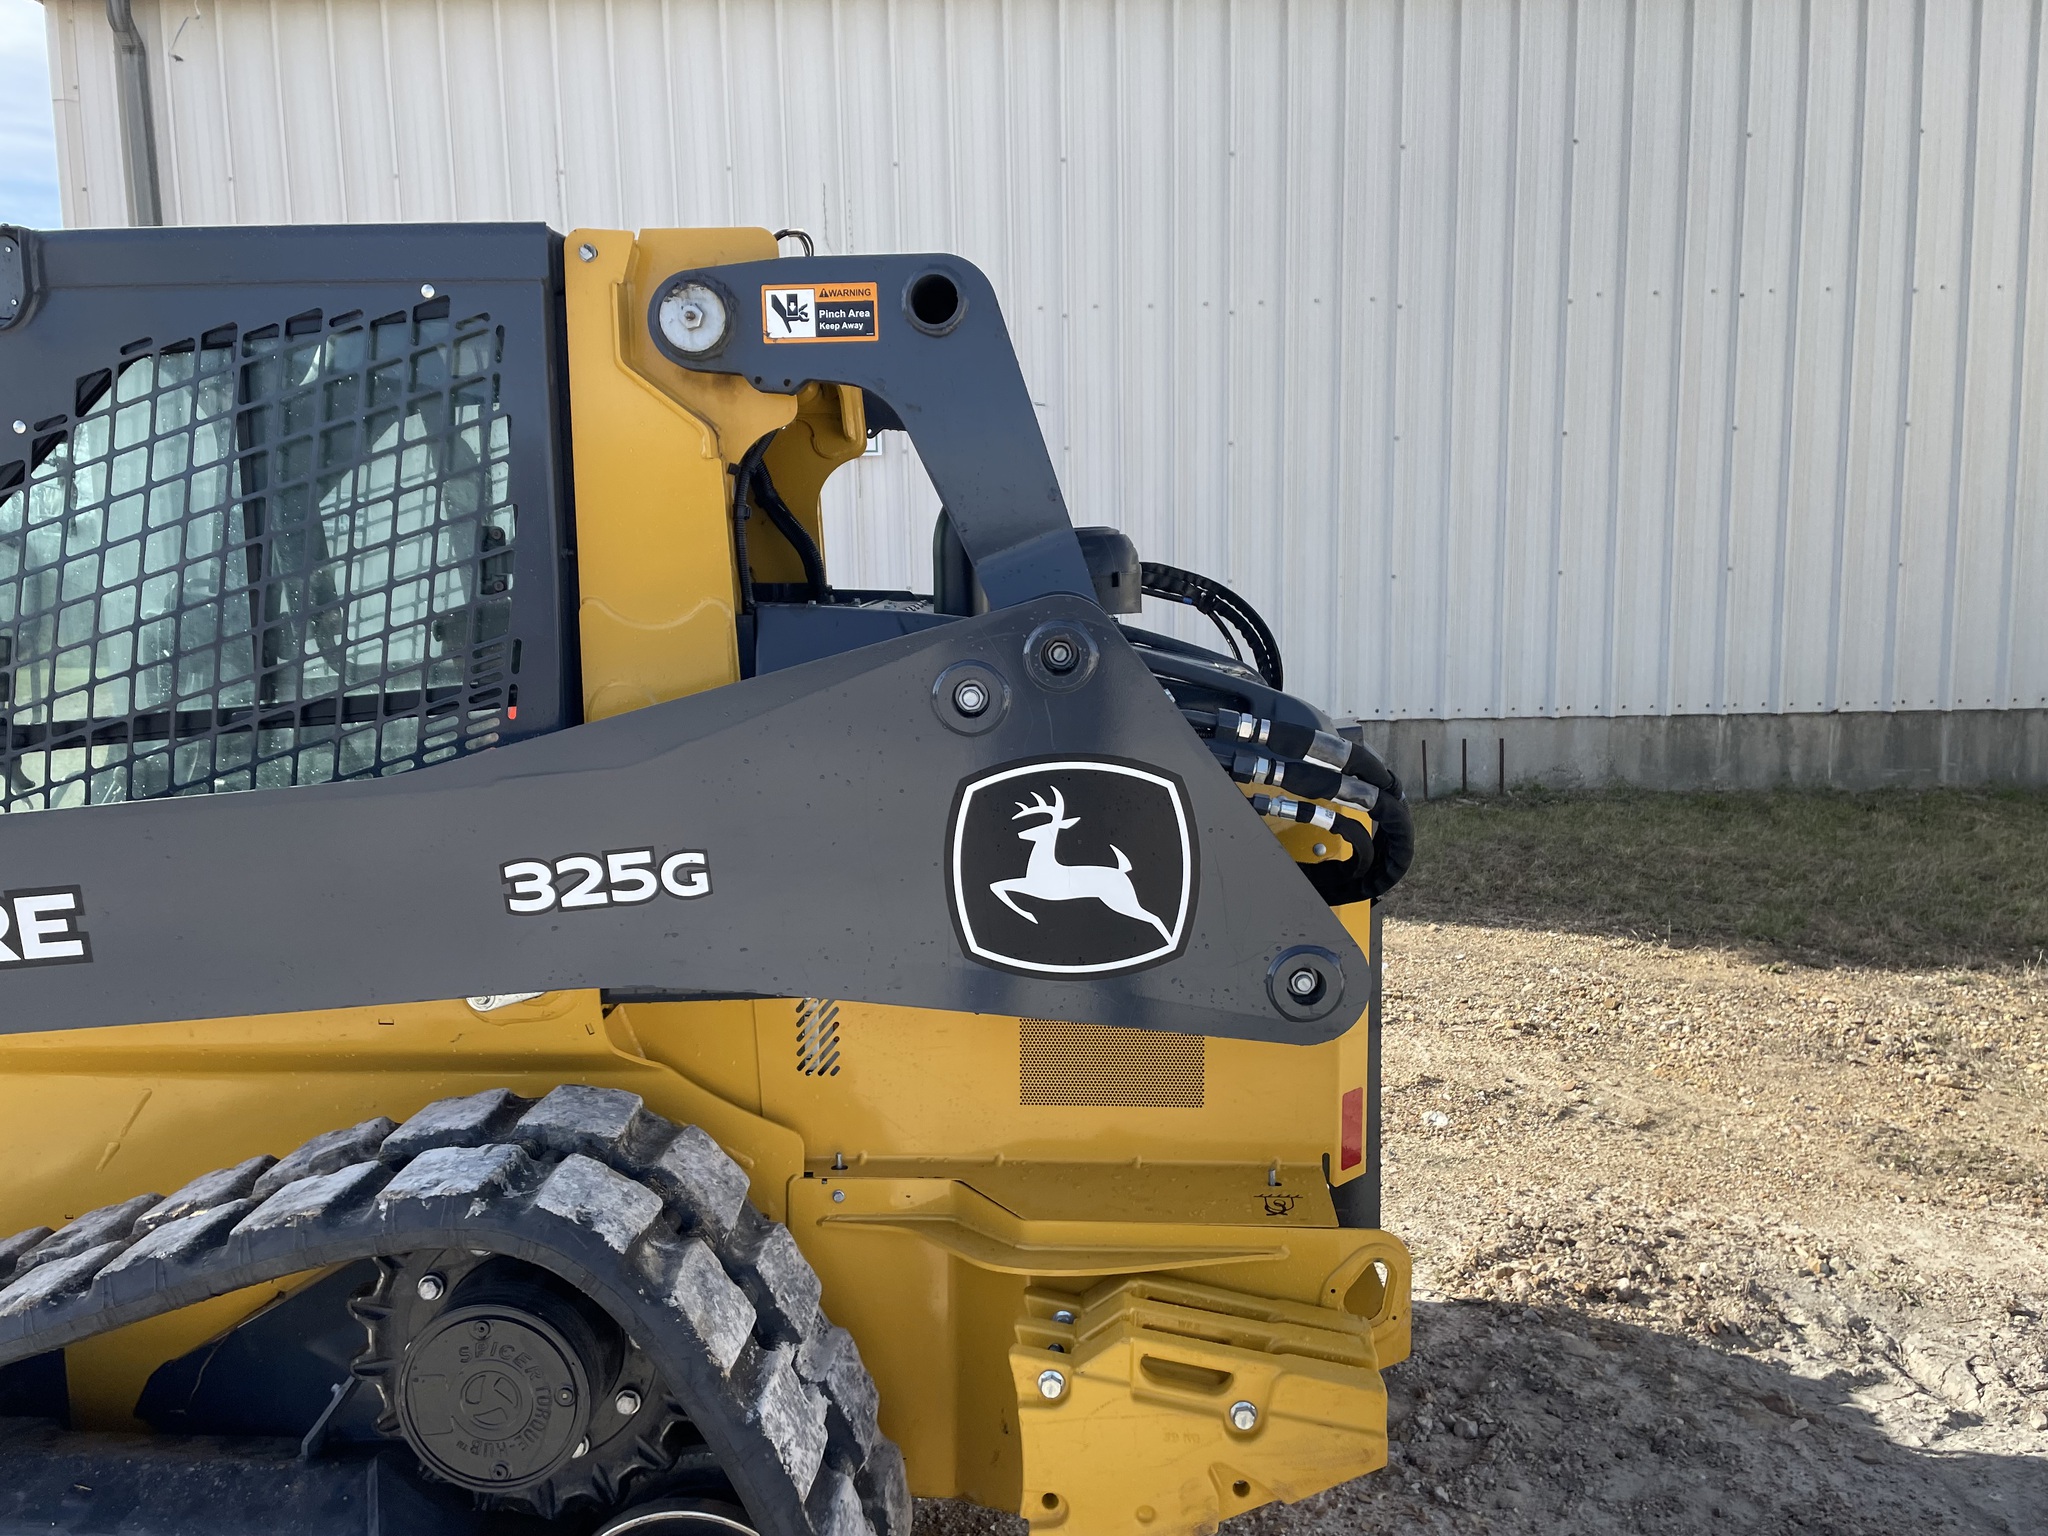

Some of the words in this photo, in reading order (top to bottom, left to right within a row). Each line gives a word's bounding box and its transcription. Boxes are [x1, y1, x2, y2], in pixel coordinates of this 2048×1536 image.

[829, 288, 871, 297] WARNING
[819, 309, 846, 319] Pinch
[849, 309, 870, 318] Area
[819, 322, 840, 331] Keep
[842, 322, 864, 331] Away
[503, 849, 711, 913] 325G
[458, 1341, 545, 1381] SPICER
